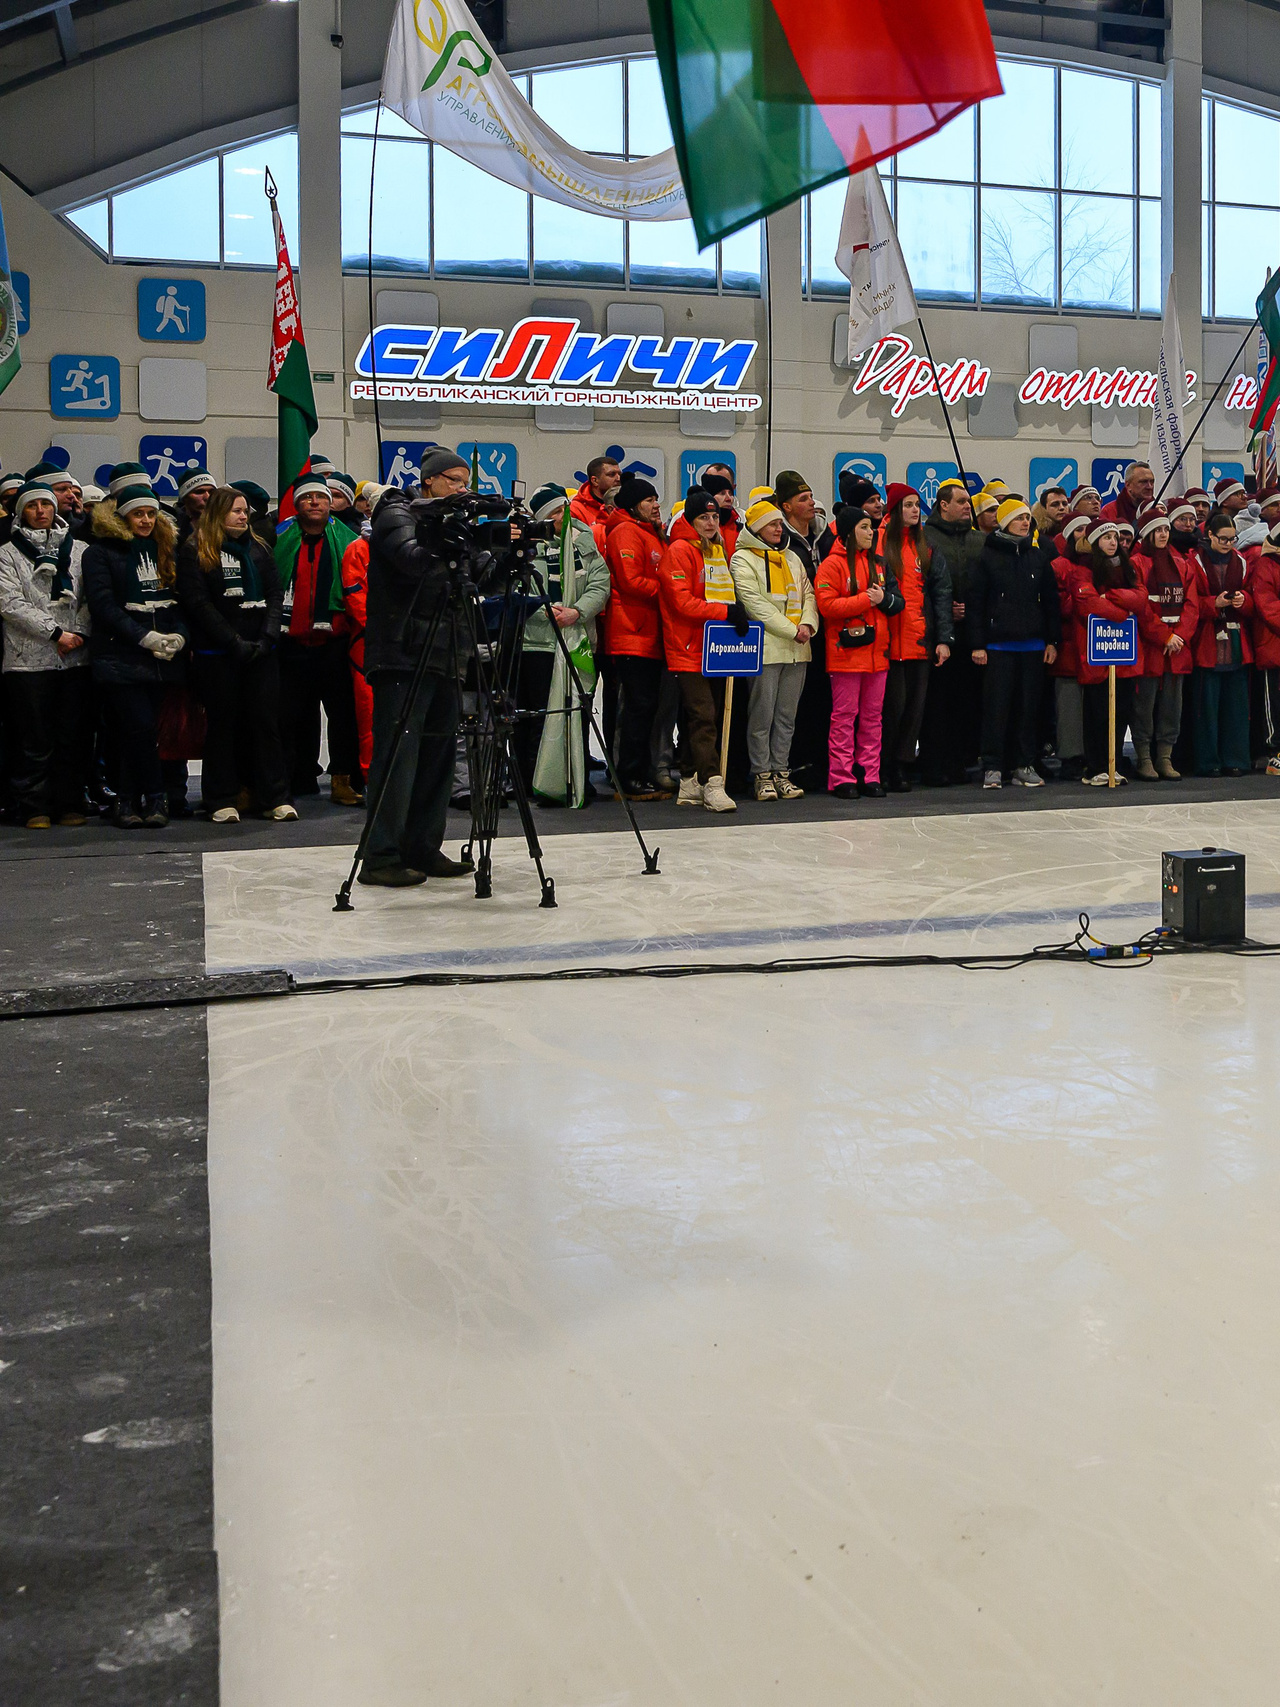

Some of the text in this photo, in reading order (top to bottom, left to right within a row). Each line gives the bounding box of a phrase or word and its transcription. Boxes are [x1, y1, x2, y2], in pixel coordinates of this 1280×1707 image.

[856, 334, 989, 415] Дарим
[353, 385, 759, 410] РЕСПУБЛИКАНСКИЙ ГОРНОЛЫЖНЫЙ ЦЕНТР
[1096, 625, 1124, 638] Моднае
[709, 641, 758, 656] Агрохолдинг
[1095, 638, 1130, 654] народнае
